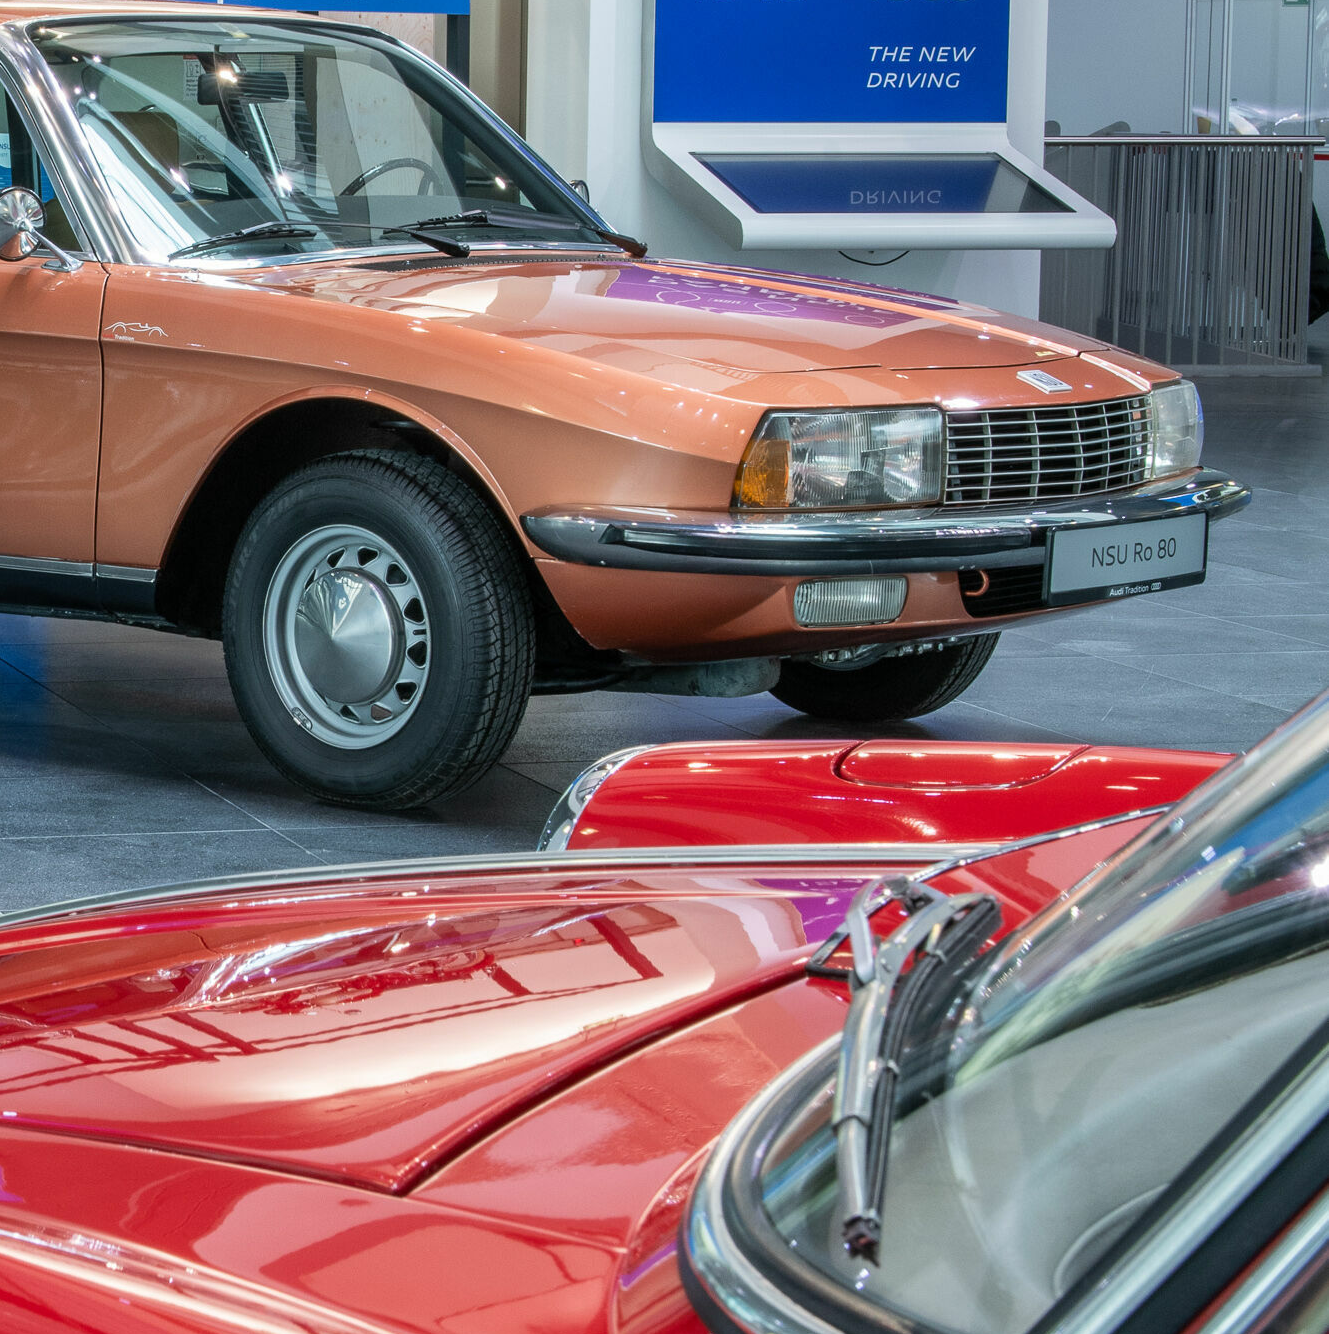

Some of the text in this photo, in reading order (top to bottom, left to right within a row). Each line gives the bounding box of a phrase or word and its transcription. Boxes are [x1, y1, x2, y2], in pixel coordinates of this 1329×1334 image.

[869, 46, 976, 63] THE NEW
[866, 72, 961, 89] DRIVING
[1092, 537, 1177, 567] NSU Ro 80
[1110, 584, 1149, 597] Audi Tradition
